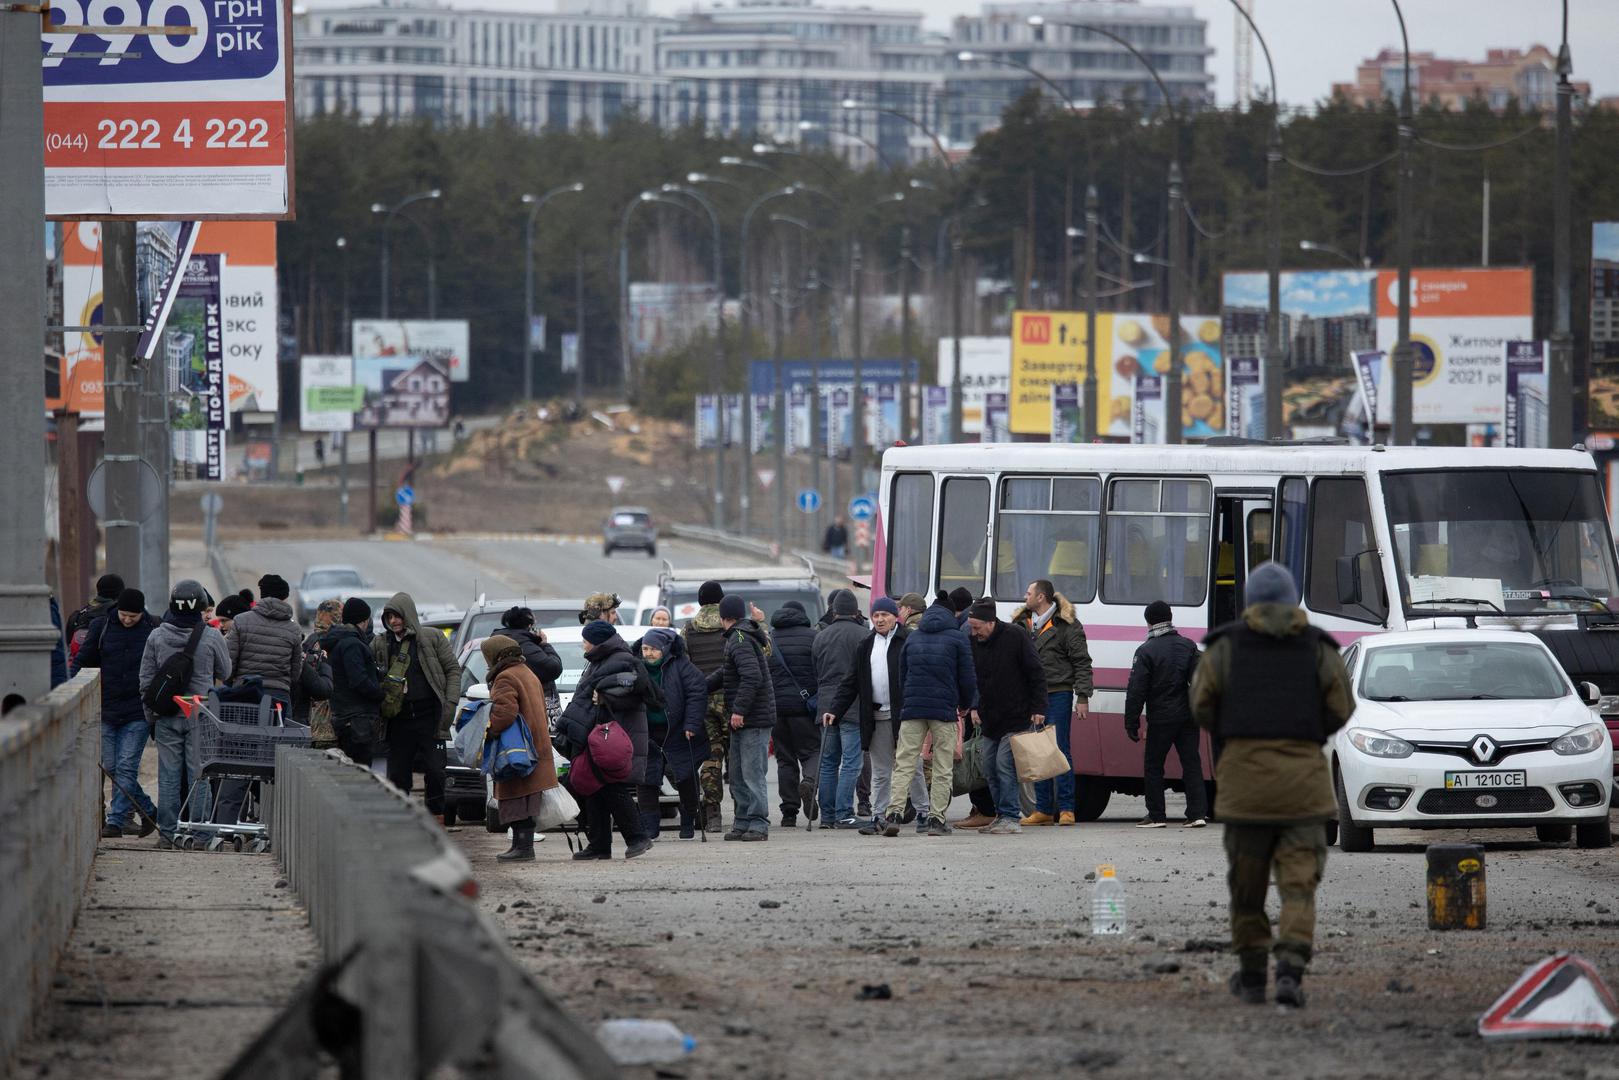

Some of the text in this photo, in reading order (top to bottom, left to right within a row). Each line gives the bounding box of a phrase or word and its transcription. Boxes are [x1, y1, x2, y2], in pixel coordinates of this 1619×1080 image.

[216, 25, 264, 57] рік
[46, 118, 269, 152] (044) 222 4 222
[226, 291, 265, 308] вий
[207, 303, 220, 353] ПАРК
[228, 344, 263, 362] оку
[175, 598, 198, 611] TV
[1454, 773, 1522, 787] AI 1210 CE
